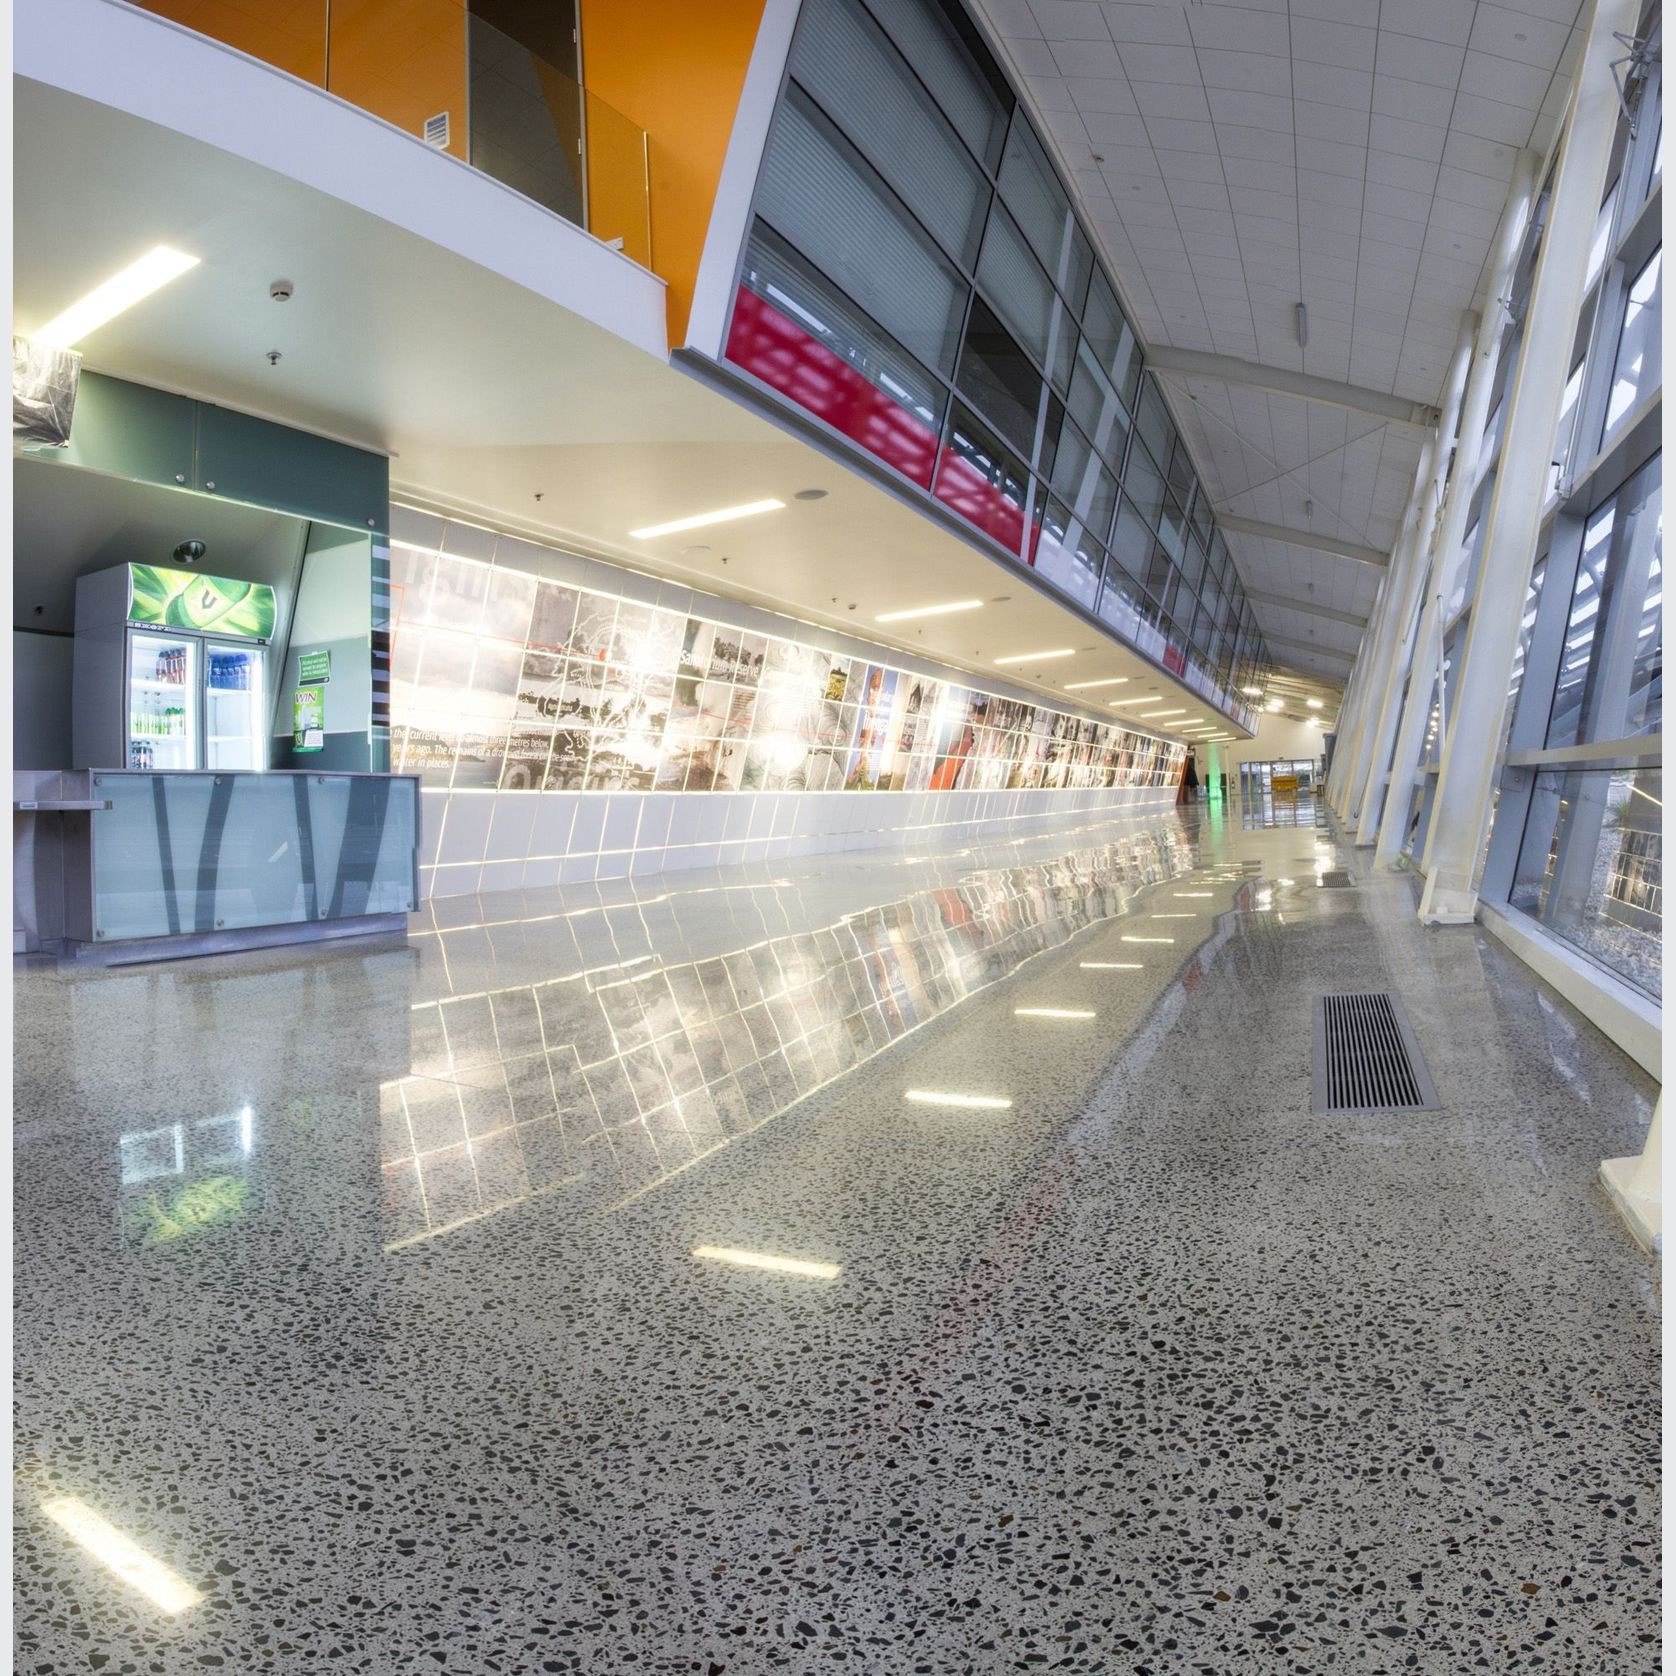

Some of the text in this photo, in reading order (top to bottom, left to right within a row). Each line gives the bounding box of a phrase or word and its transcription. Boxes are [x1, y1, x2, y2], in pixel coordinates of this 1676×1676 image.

[730, 660, 759, 679] Rserve
[295, 692, 317, 703] WIN
[410, 730, 438, 741] current
[509, 738, 530, 748] metres
[393, 744, 415, 754] yers
[416, 745, 432, 756] ago.
[435, 744, 448, 755] The
[449, 748, 477, 758] reains
[393, 758, 416, 768] wter
[418, 759, 426, 768] in
